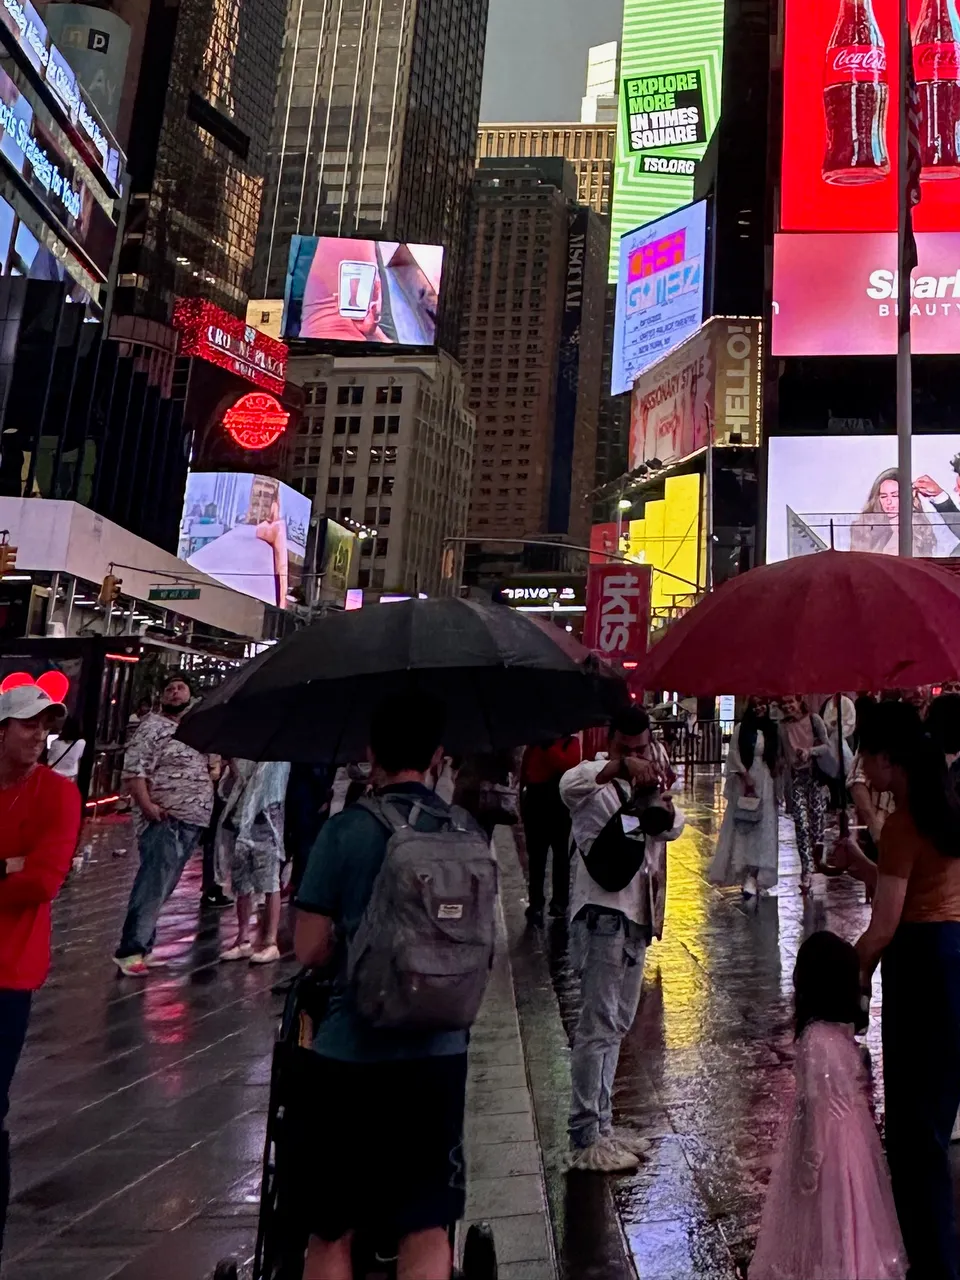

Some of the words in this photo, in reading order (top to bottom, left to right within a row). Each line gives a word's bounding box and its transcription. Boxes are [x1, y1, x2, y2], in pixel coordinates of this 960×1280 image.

[627, 73, 698, 97] EXPLORE
[629, 93, 676, 114] MORE
[630, 113, 648, 132] IN
[649, 107, 699, 129] TIMES
[631, 125, 698, 150] SQUARE
[726, 325, 751, 442] HELLO!
[599, 572, 640, 653] tkts
